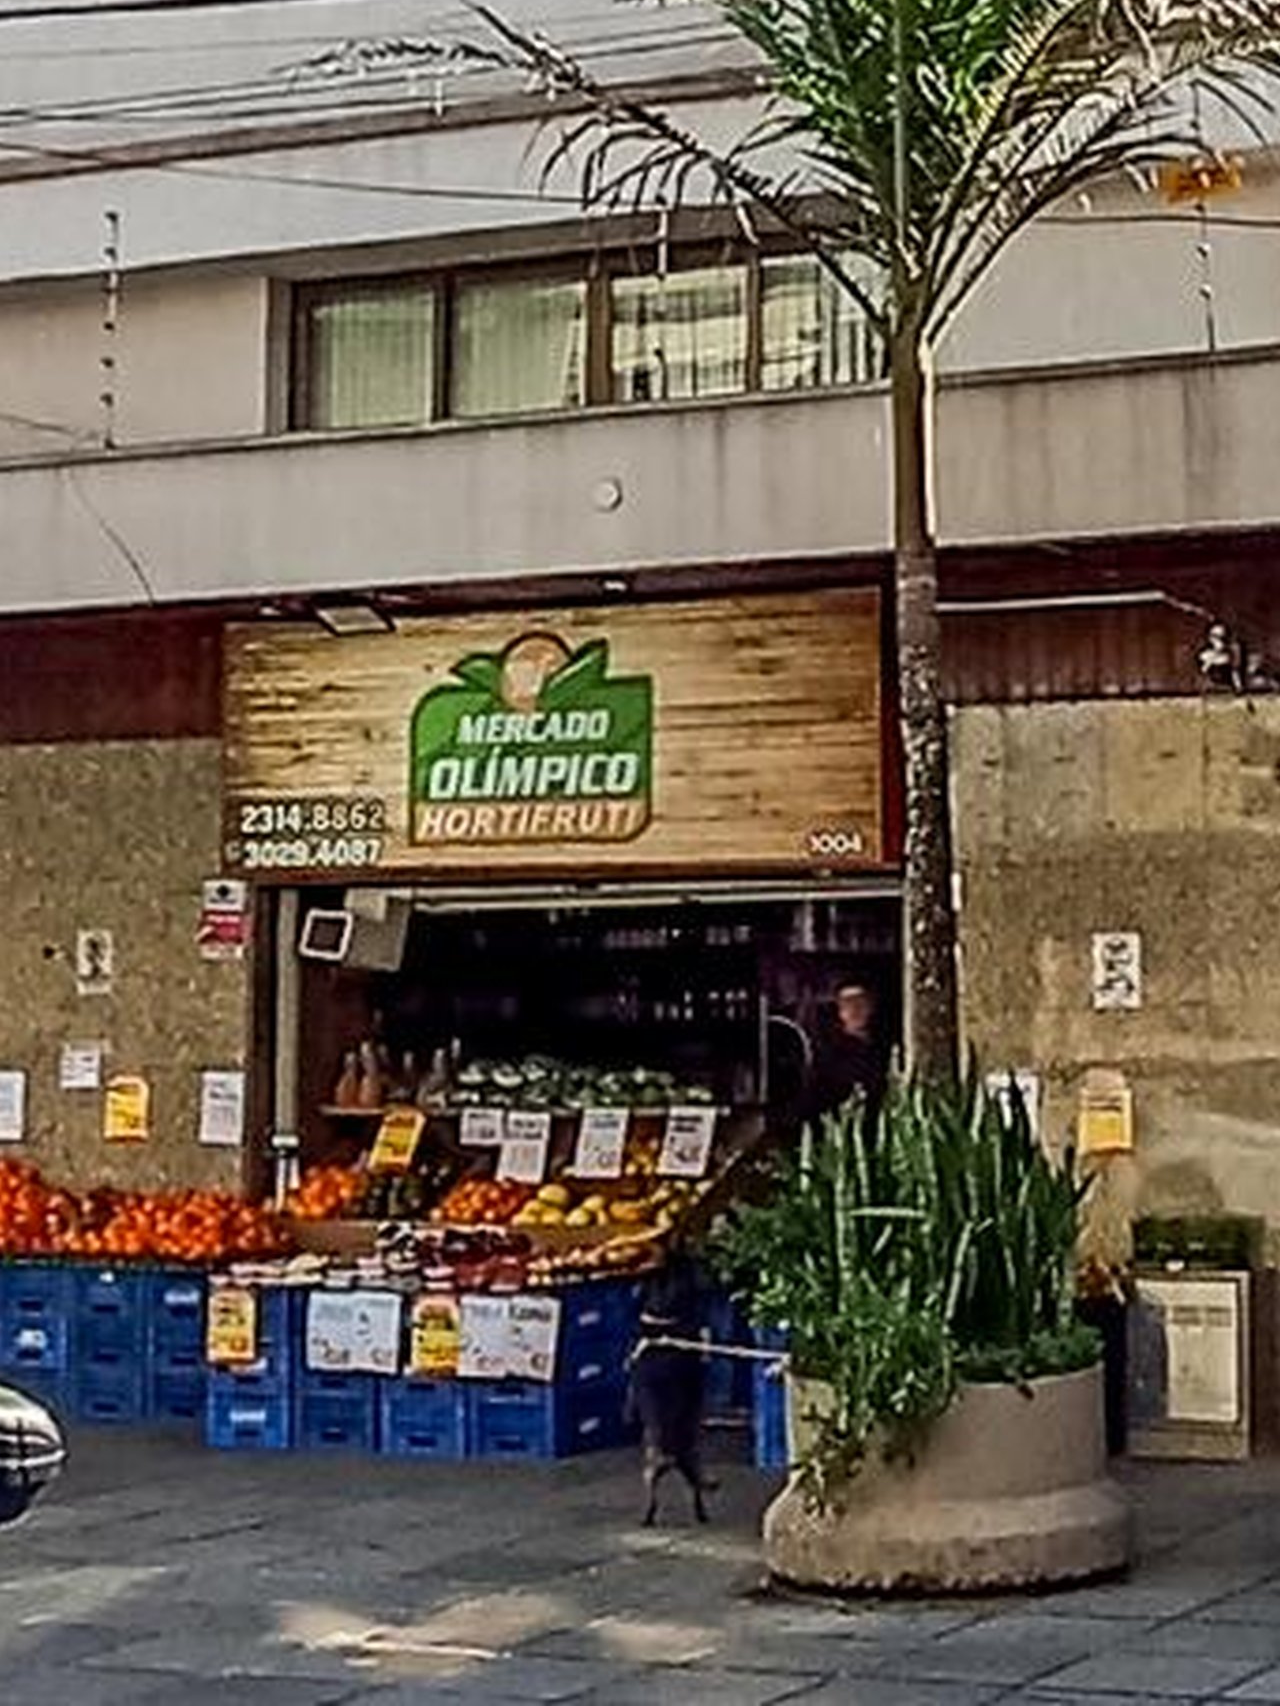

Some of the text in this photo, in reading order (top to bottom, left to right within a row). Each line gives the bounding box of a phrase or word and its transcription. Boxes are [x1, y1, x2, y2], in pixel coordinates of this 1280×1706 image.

[456, 709, 611, 745] MERCADO
[428, 745, 639, 800] OLÍMPICO
[239, 801, 386, 835] 2314.8862
[414, 802, 639, 842] HORTIFRUTI
